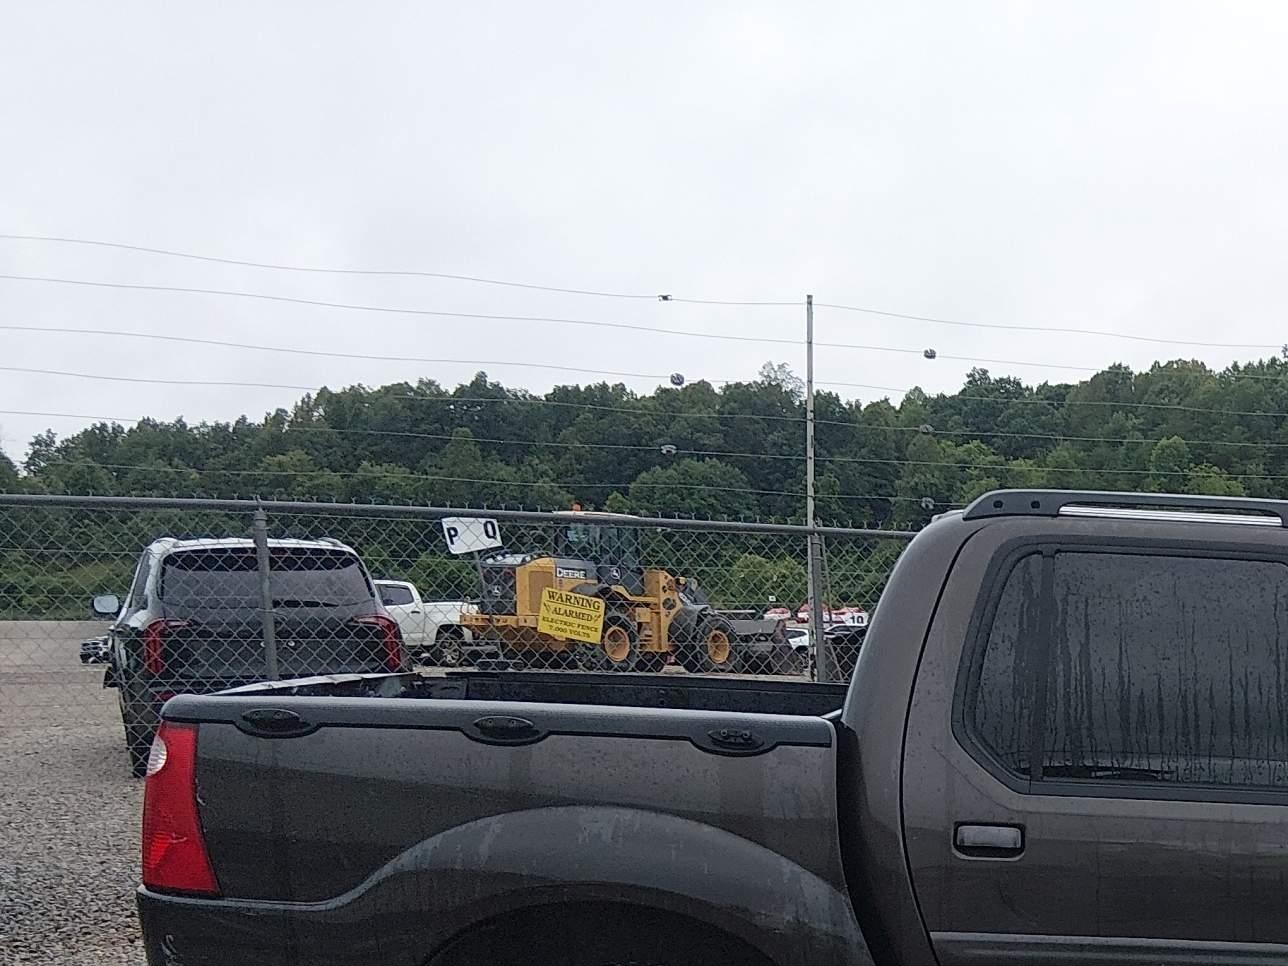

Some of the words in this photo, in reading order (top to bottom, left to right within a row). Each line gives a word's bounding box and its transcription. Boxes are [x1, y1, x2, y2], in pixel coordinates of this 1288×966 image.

[446, 526, 459, 545] P
[483, 520, 498, 539] Q
[557, 567, 586, 579] DEERE
[547, 590, 601, 611] WARNING
[552, 607, 593, 622] ALARMED
[849, 615, 864, 624] 10
[542, 616, 577, 628] ELECTRIC
[577, 623, 599, 633] FENCE
[569, 628, 591, 638] VOLTS
